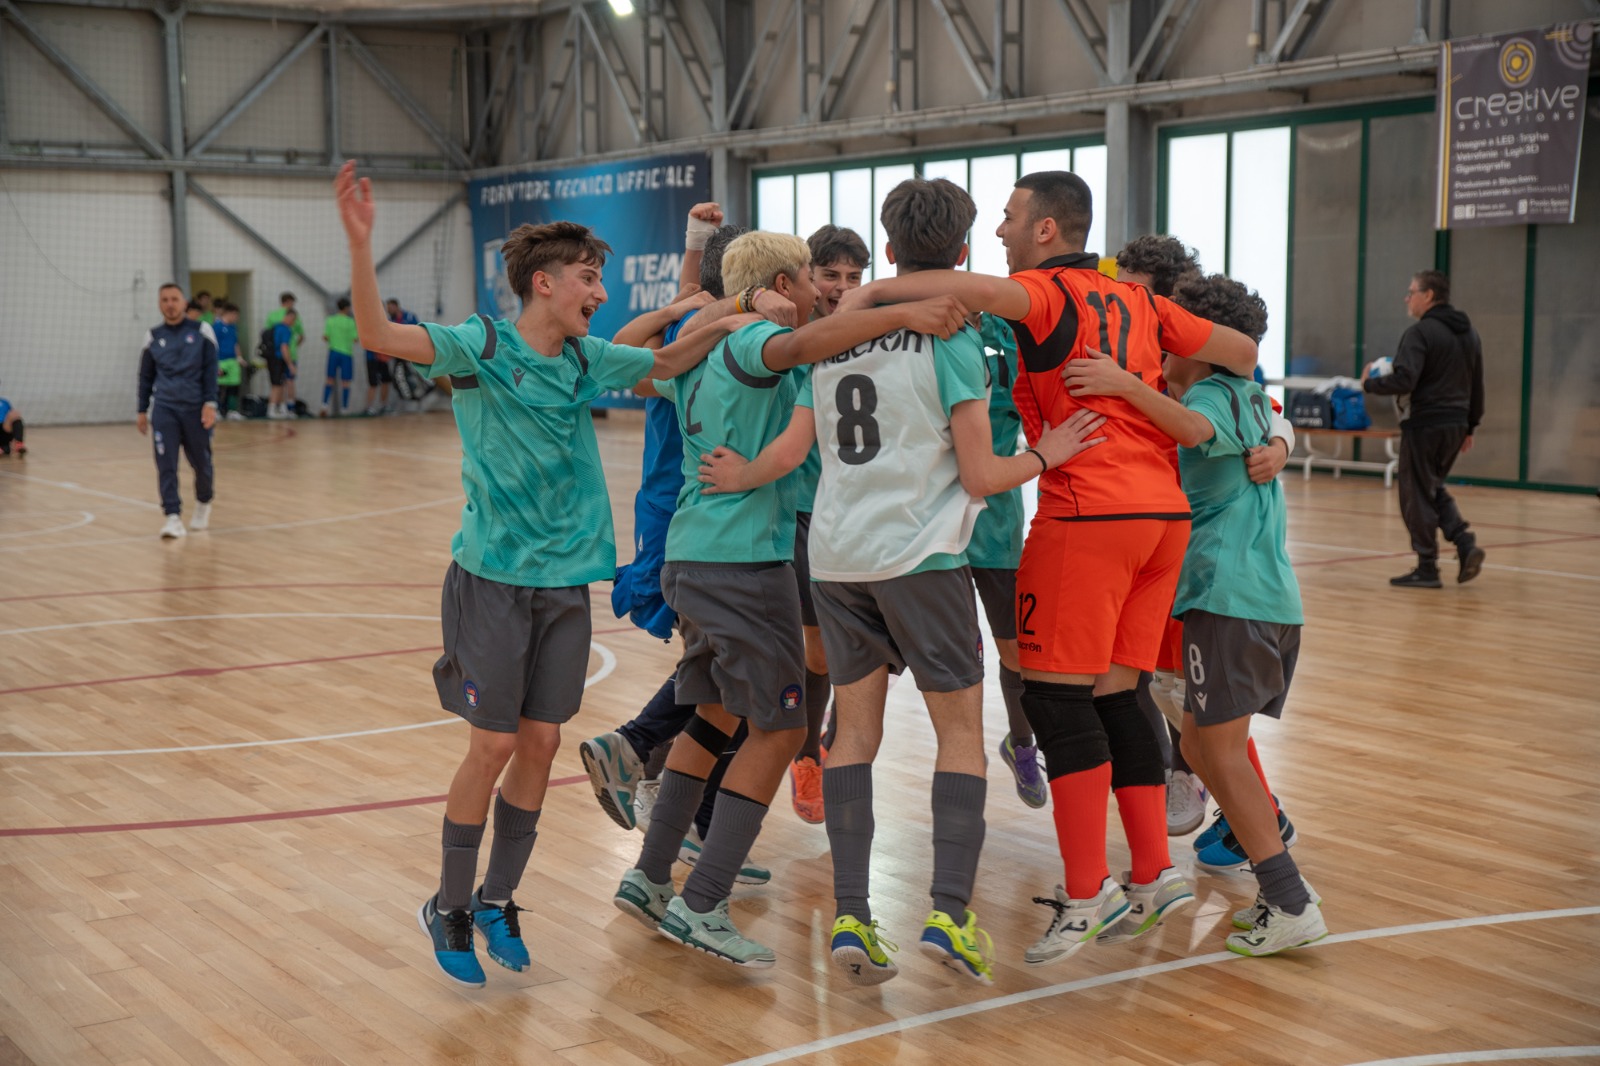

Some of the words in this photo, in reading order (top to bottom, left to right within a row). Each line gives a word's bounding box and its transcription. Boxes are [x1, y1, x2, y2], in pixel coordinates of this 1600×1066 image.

[1455, 85, 1580, 119] creative
[835, 373, 881, 465] 8
[1019, 592, 1036, 635] 12
[1189, 643, 1206, 685] 8
